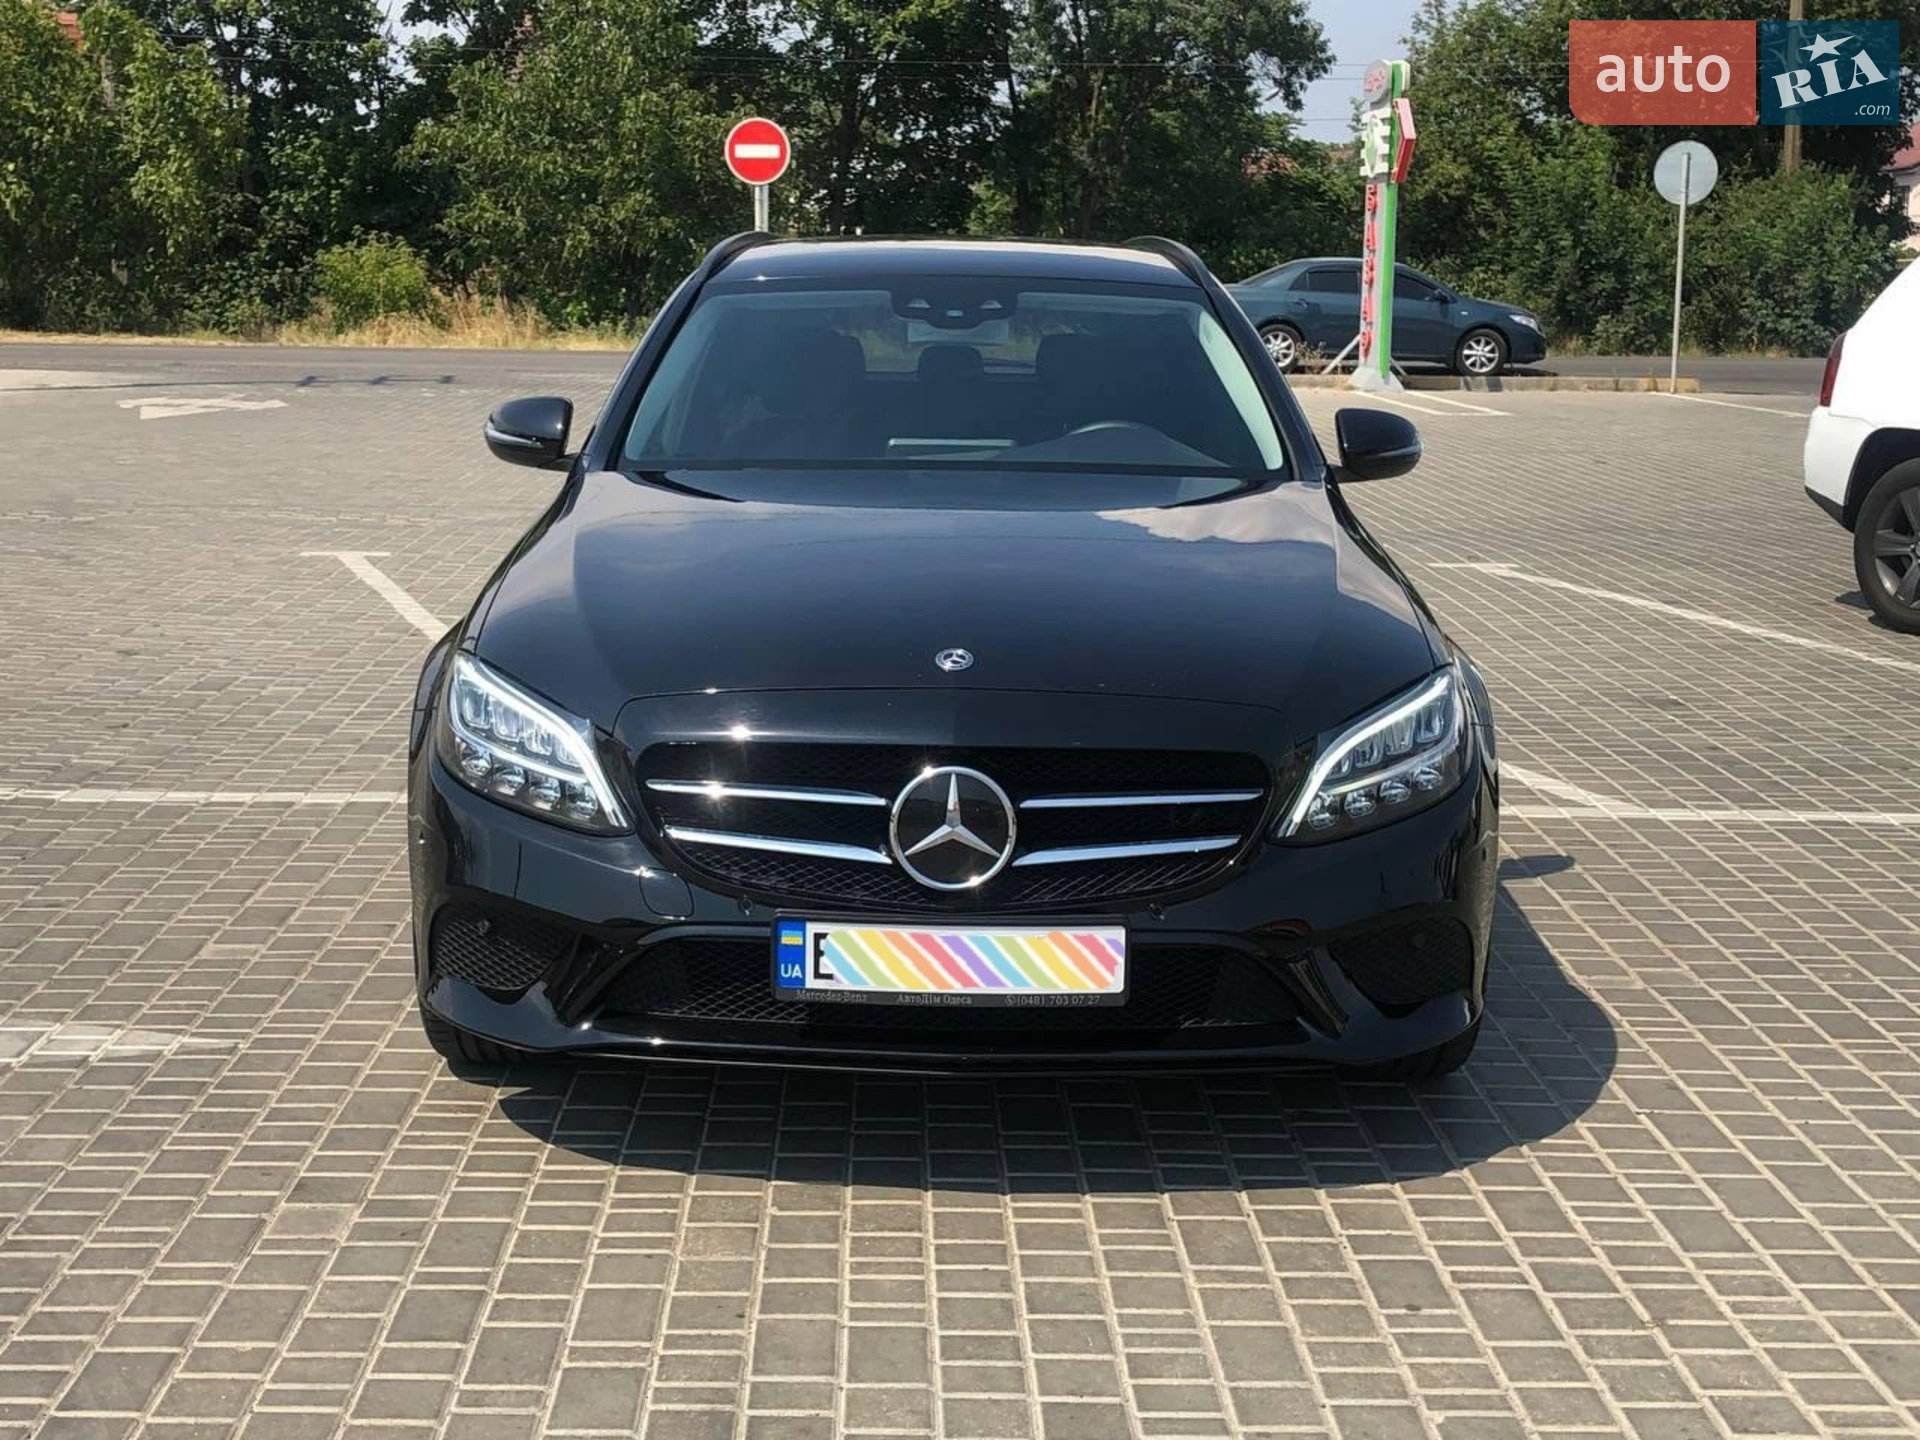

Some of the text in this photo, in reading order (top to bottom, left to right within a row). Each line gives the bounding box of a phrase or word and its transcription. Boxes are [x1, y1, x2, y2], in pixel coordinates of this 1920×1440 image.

[780, 963, 803, 979] UA
[795, 990, 868, 1003] Mercedes-Benz
[1049, 995, 1069, 1006] 703
[1071, 995, 1084, 1005] 07
[1088, 995, 1101, 1005] 27
